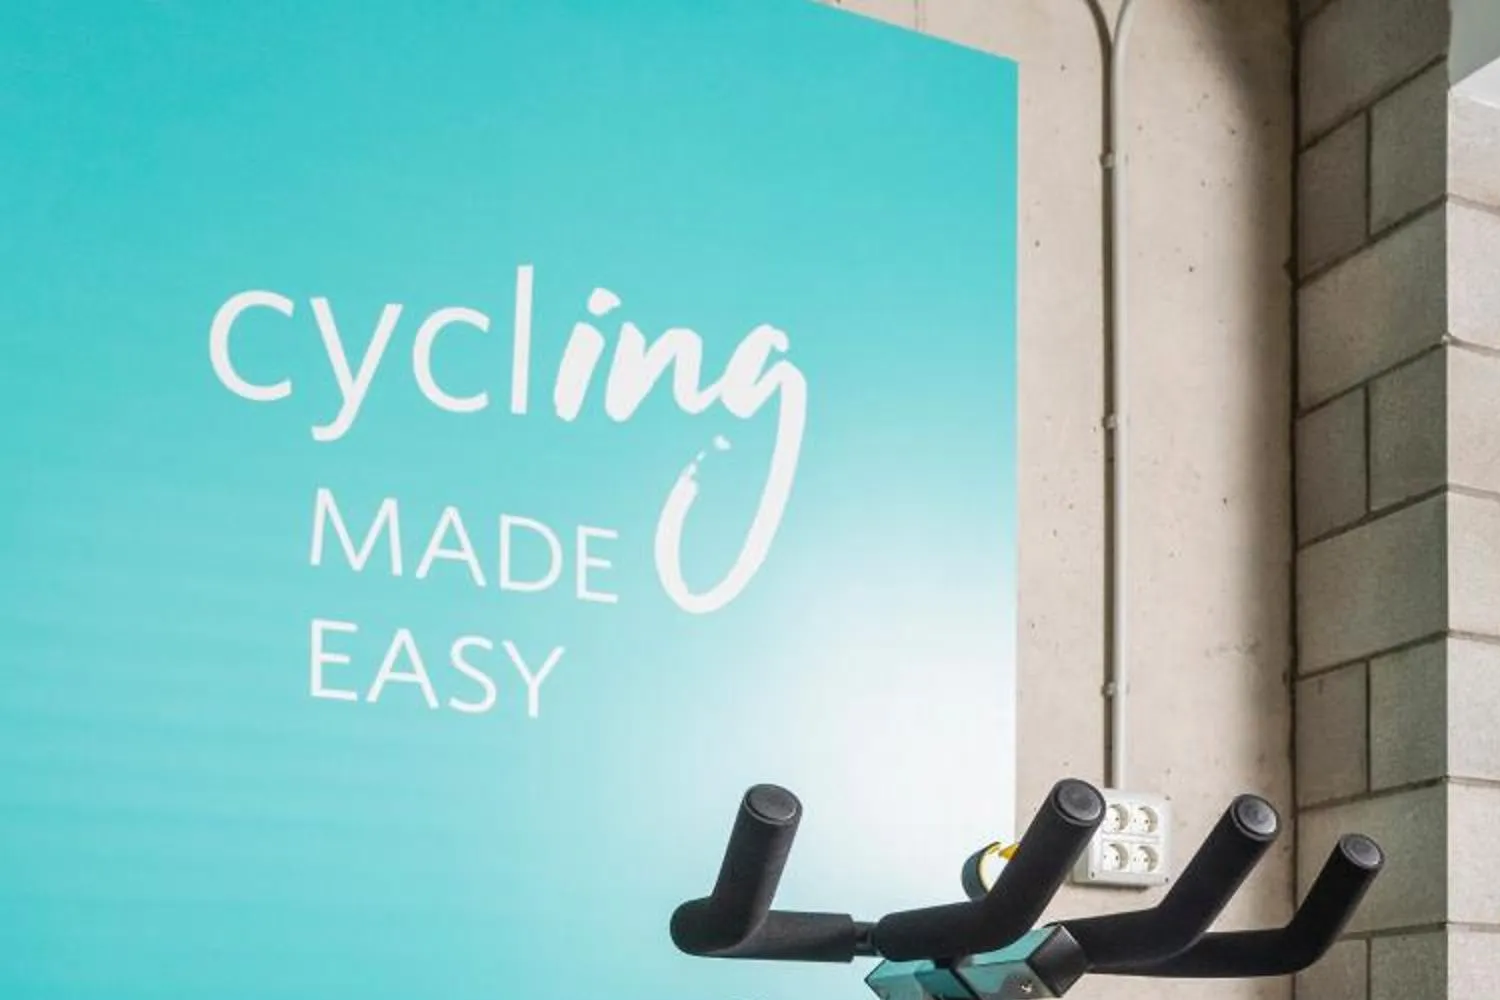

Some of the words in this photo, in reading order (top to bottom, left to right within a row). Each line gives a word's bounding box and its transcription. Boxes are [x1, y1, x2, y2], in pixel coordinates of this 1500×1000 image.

[208, 264, 808, 616] cycling
[309, 487, 621, 604] MADE
[309, 617, 566, 718] EASY
